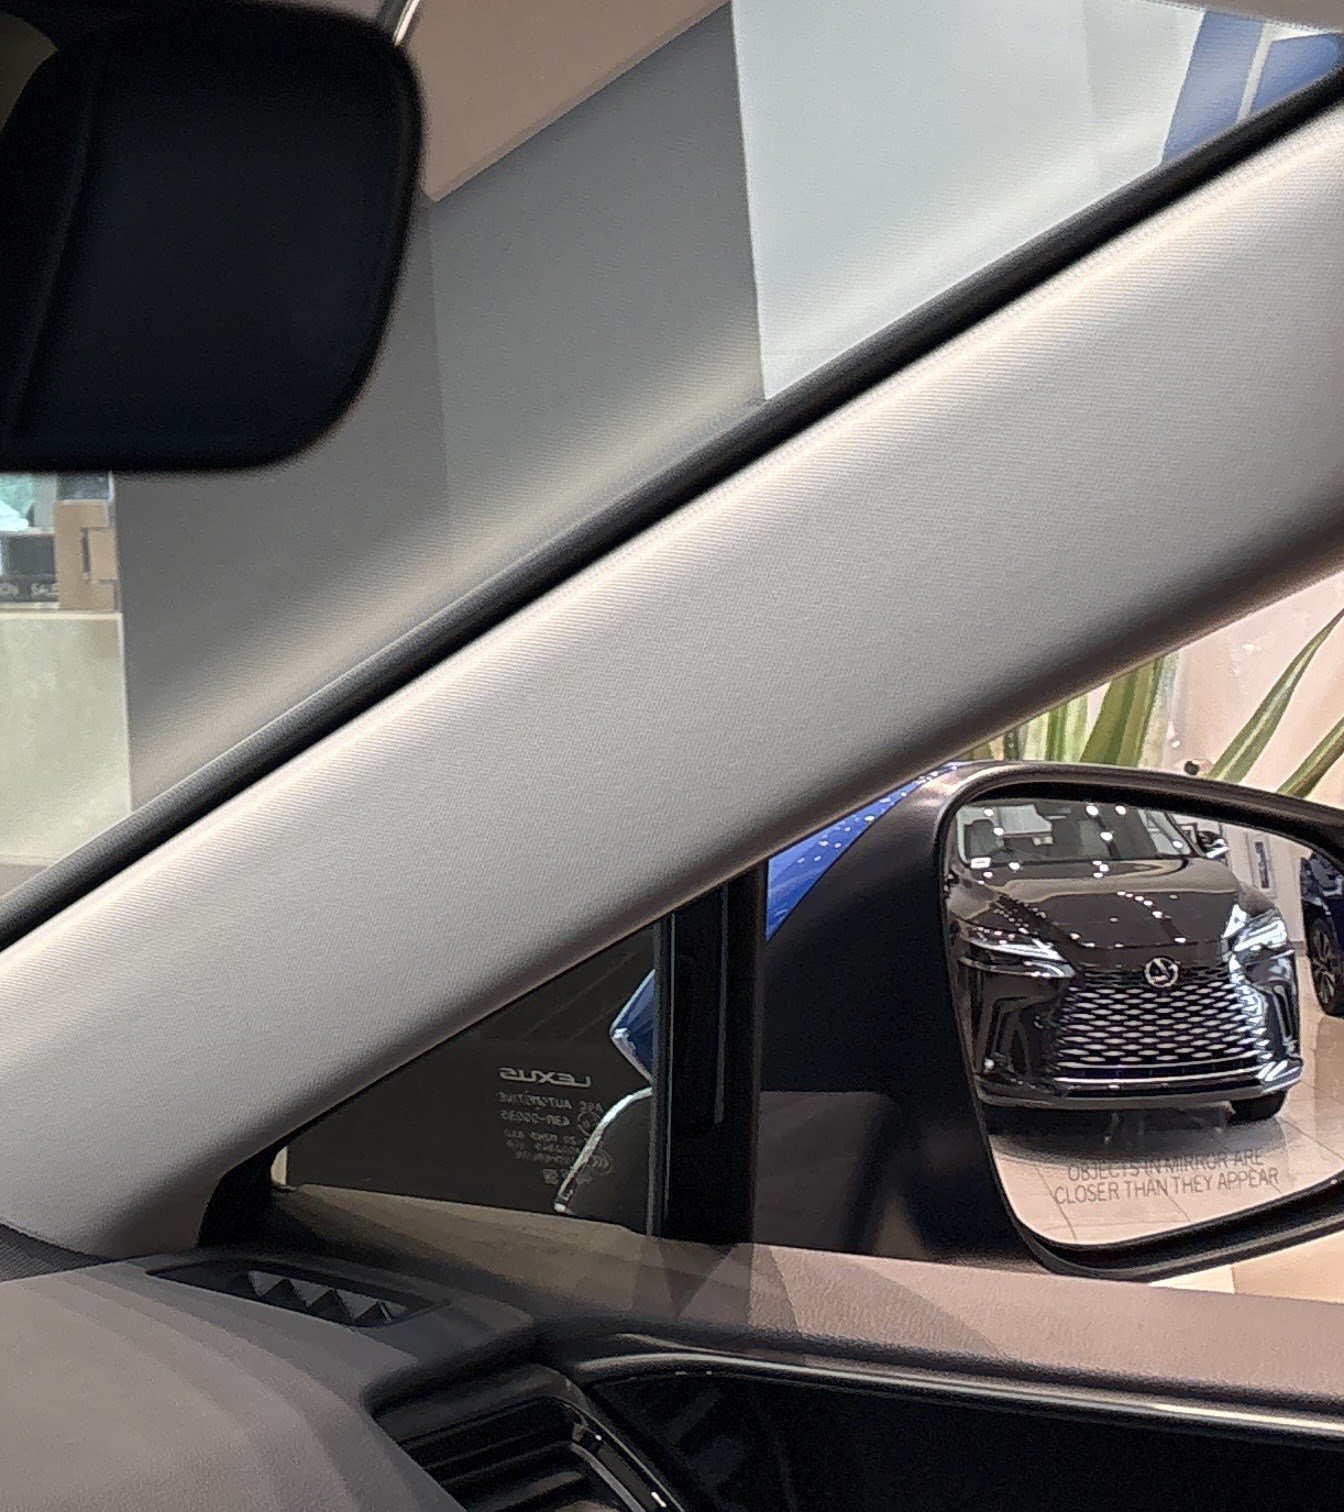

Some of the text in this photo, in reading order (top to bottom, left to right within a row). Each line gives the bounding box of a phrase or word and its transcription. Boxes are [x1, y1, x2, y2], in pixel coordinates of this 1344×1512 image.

[1067, 1160, 1140, 1182] OBJECTS
[1164, 1152, 1227, 1173] MIRROR
[1232, 1149, 1265, 1168] ARE
[1055, 1168, 1280, 1205] CLOSER THAN THEY APPEAR
